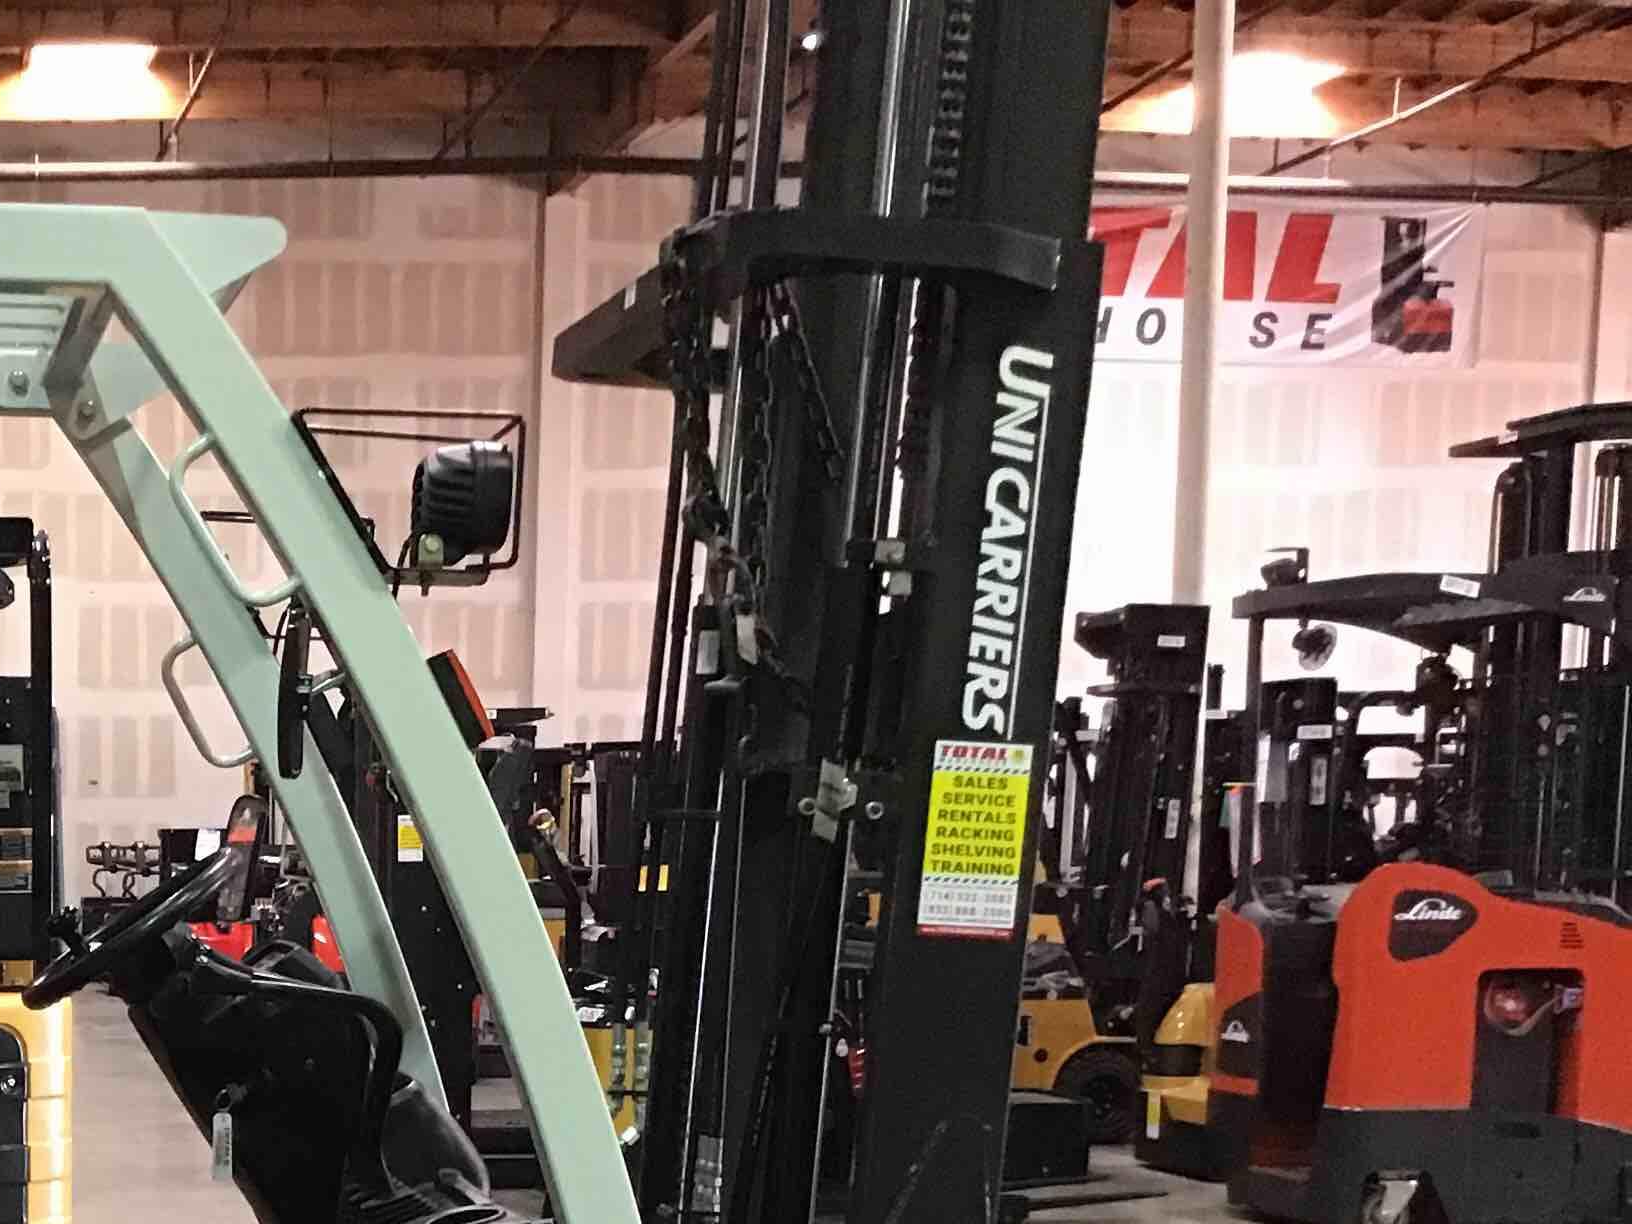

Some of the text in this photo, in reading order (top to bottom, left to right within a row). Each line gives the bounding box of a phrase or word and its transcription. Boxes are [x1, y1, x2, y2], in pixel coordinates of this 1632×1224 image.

[1095, 306, 1333, 350] OSE
[962, 345, 1055, 735] UNICARRIERS
[941, 745, 1008, 760] TOTAL
[952, 775, 1008, 790] SALES
[942, 792, 1016, 808] SERVICE
[937, 809, 1016, 825] RENTALS
[935, 826, 1015, 842] RACKING
[931, 843, 1016, 859] SHELVING
[930, 860, 1015, 876] TRAINING
[1394, 898, 1463, 921] Linde
